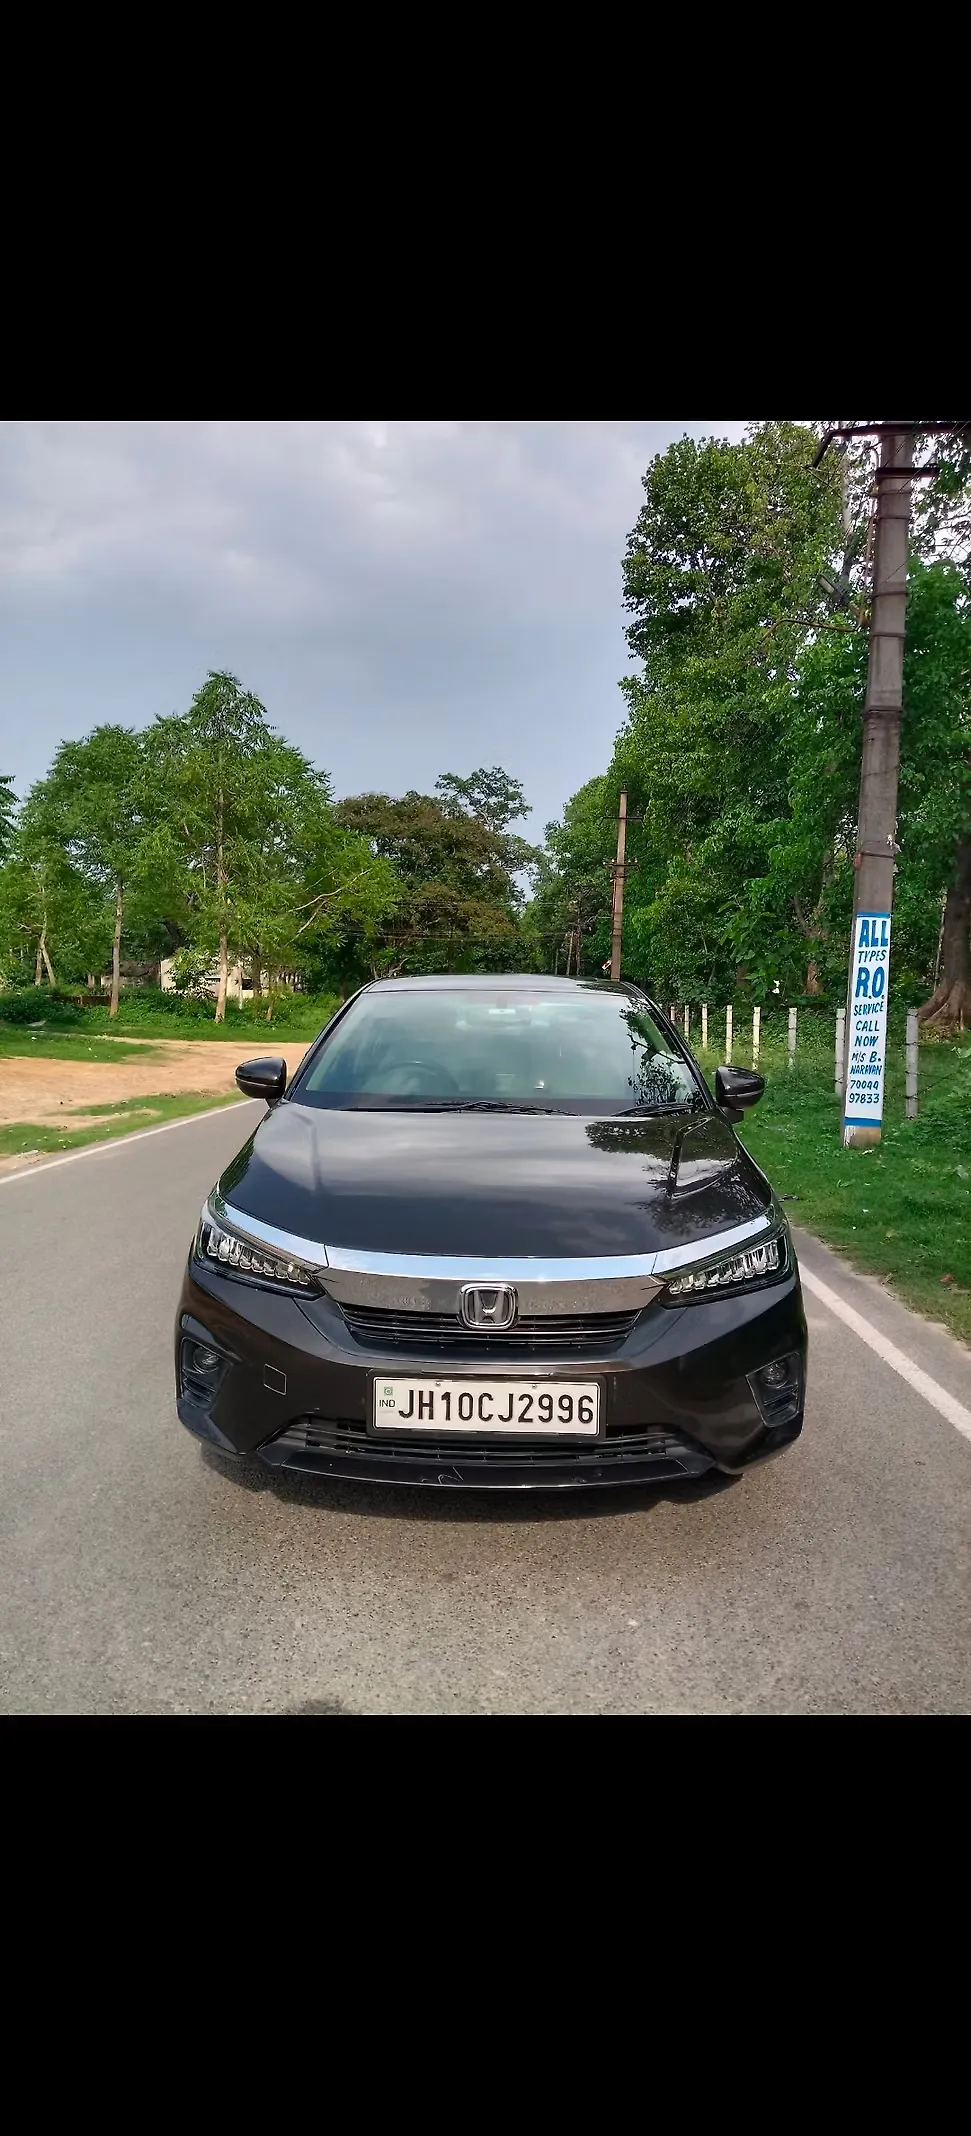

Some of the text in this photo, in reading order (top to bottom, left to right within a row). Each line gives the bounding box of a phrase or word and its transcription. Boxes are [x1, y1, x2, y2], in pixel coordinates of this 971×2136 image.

[859, 919, 889, 948] ALL
[858, 950, 887, 964] TYPES
[855, 966, 885, 999] R.O.
[854, 1001, 885, 1017] SERVICE
[855, 1020, 881, 1032] CALL
[854, 1035, 879, 1047] NOW
[869, 1051, 882, 1063] B.
[848, 1092, 881, 1104] 97833
[379, 1399, 396, 1408] IND
[398, 1389, 594, 1424] JH10CJ2996
